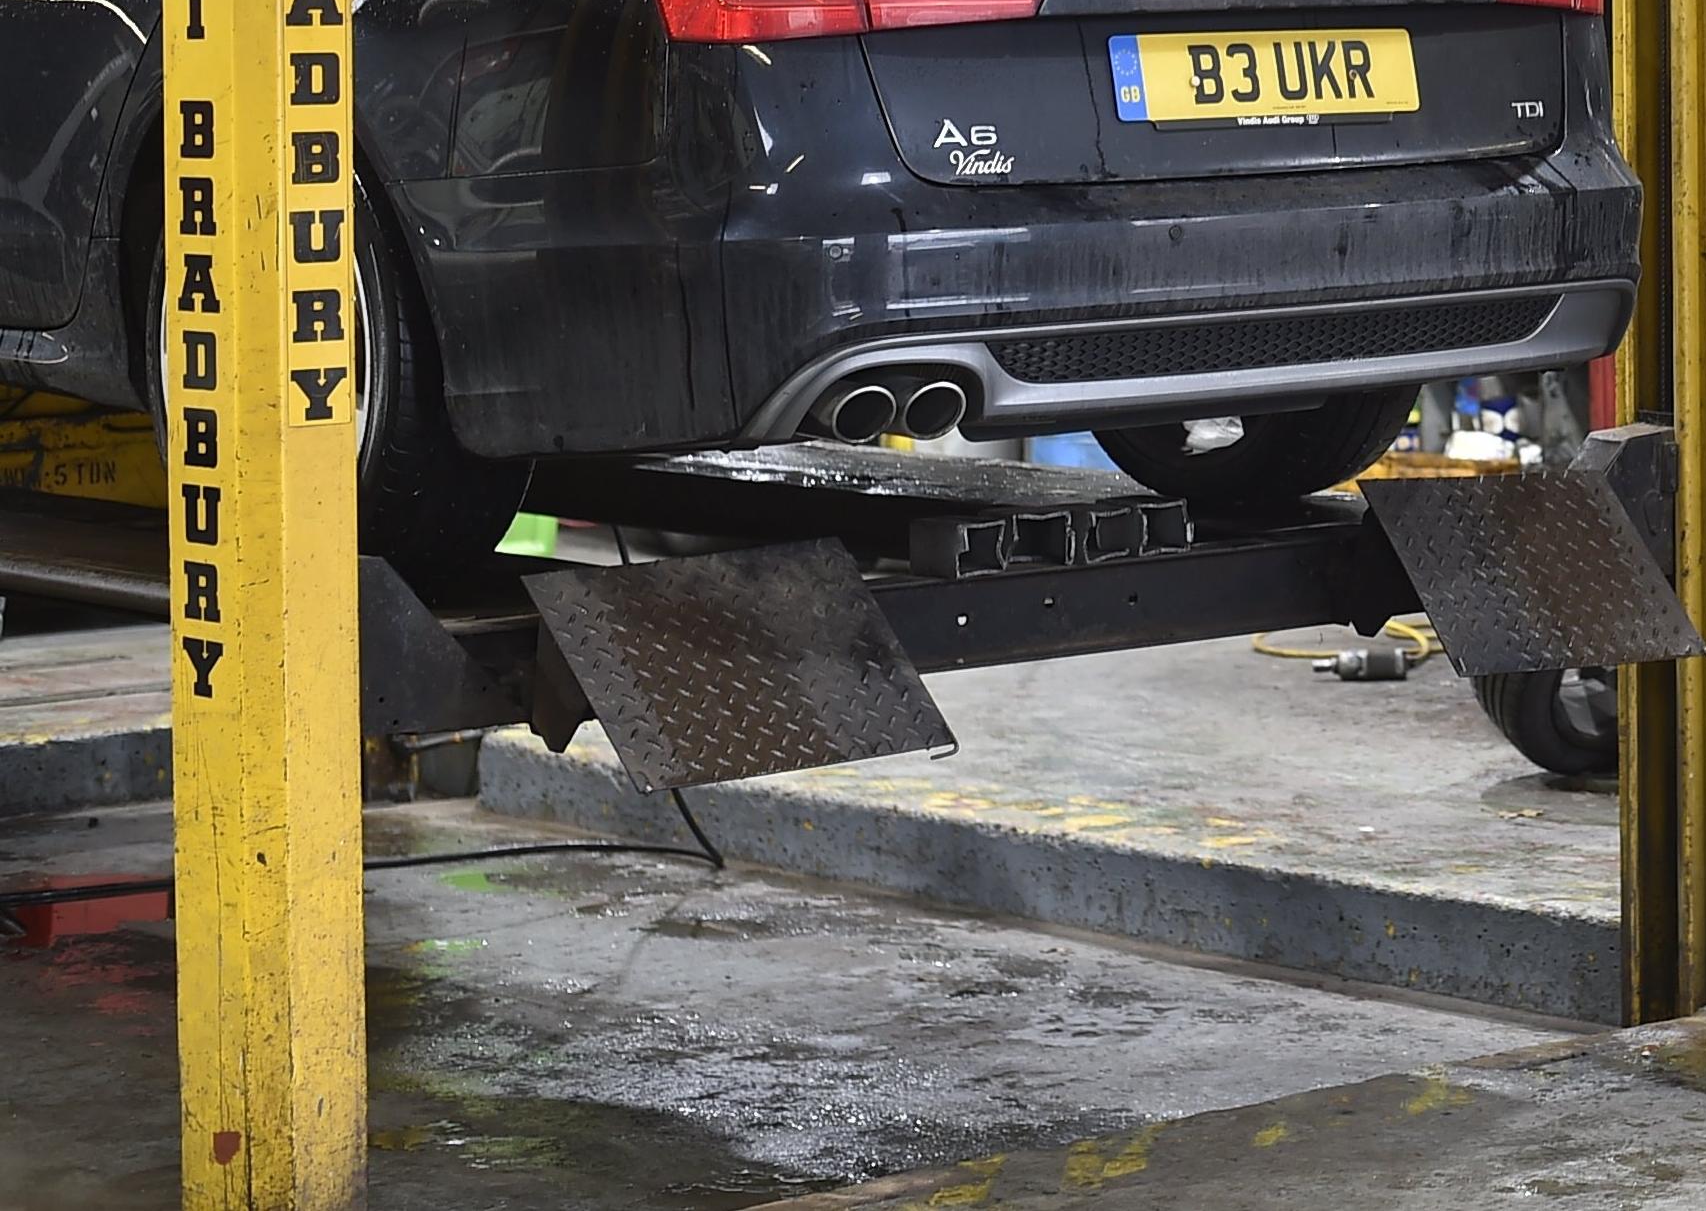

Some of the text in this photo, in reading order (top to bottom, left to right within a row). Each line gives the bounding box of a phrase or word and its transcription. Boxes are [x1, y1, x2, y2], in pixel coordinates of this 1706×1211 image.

[1187, 40, 1376, 106] B3 UKR
[1121, 86, 1141, 103] GB
[1237, 115, 1305, 126] Vindis Audi Group
[1511, 100, 1544, 118] TDI
[933, 118, 998, 148] A6
[949, 149, 1015, 176] Vindis
[177, 100, 224, 699] BRADBURY
